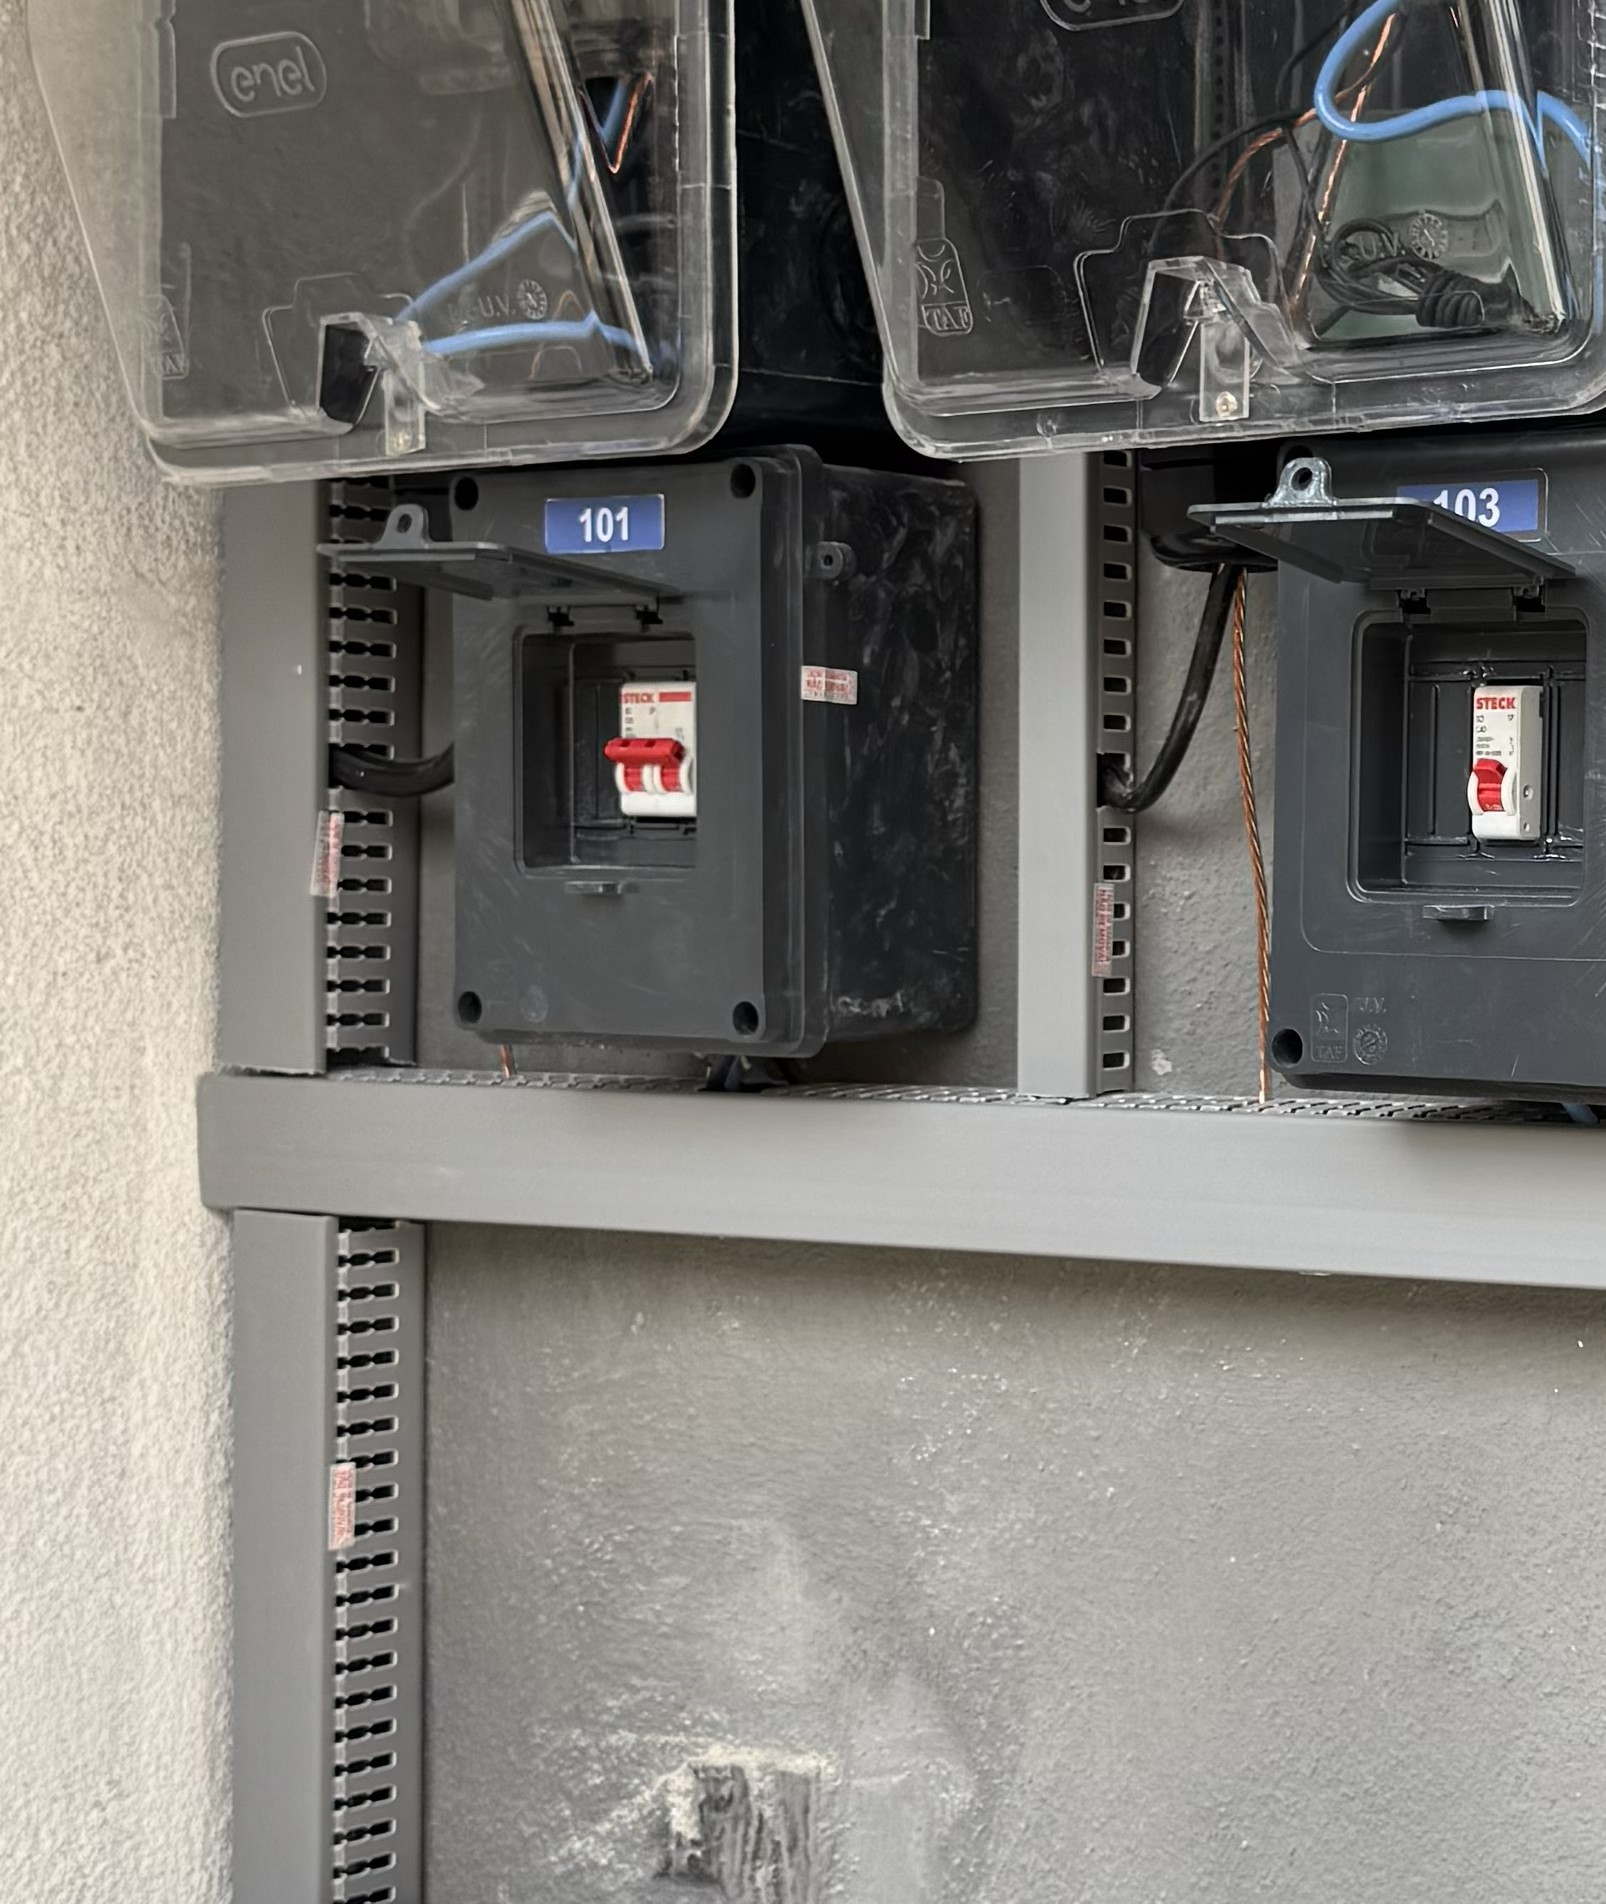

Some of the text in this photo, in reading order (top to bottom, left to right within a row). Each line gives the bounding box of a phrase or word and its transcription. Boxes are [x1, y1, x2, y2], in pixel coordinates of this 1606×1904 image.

[230, 45, 316, 104] enel
[580, 507, 629, 543] 101
[623, 692, 655, 704] STECK
[1476, 697, 1516, 710] STECK
